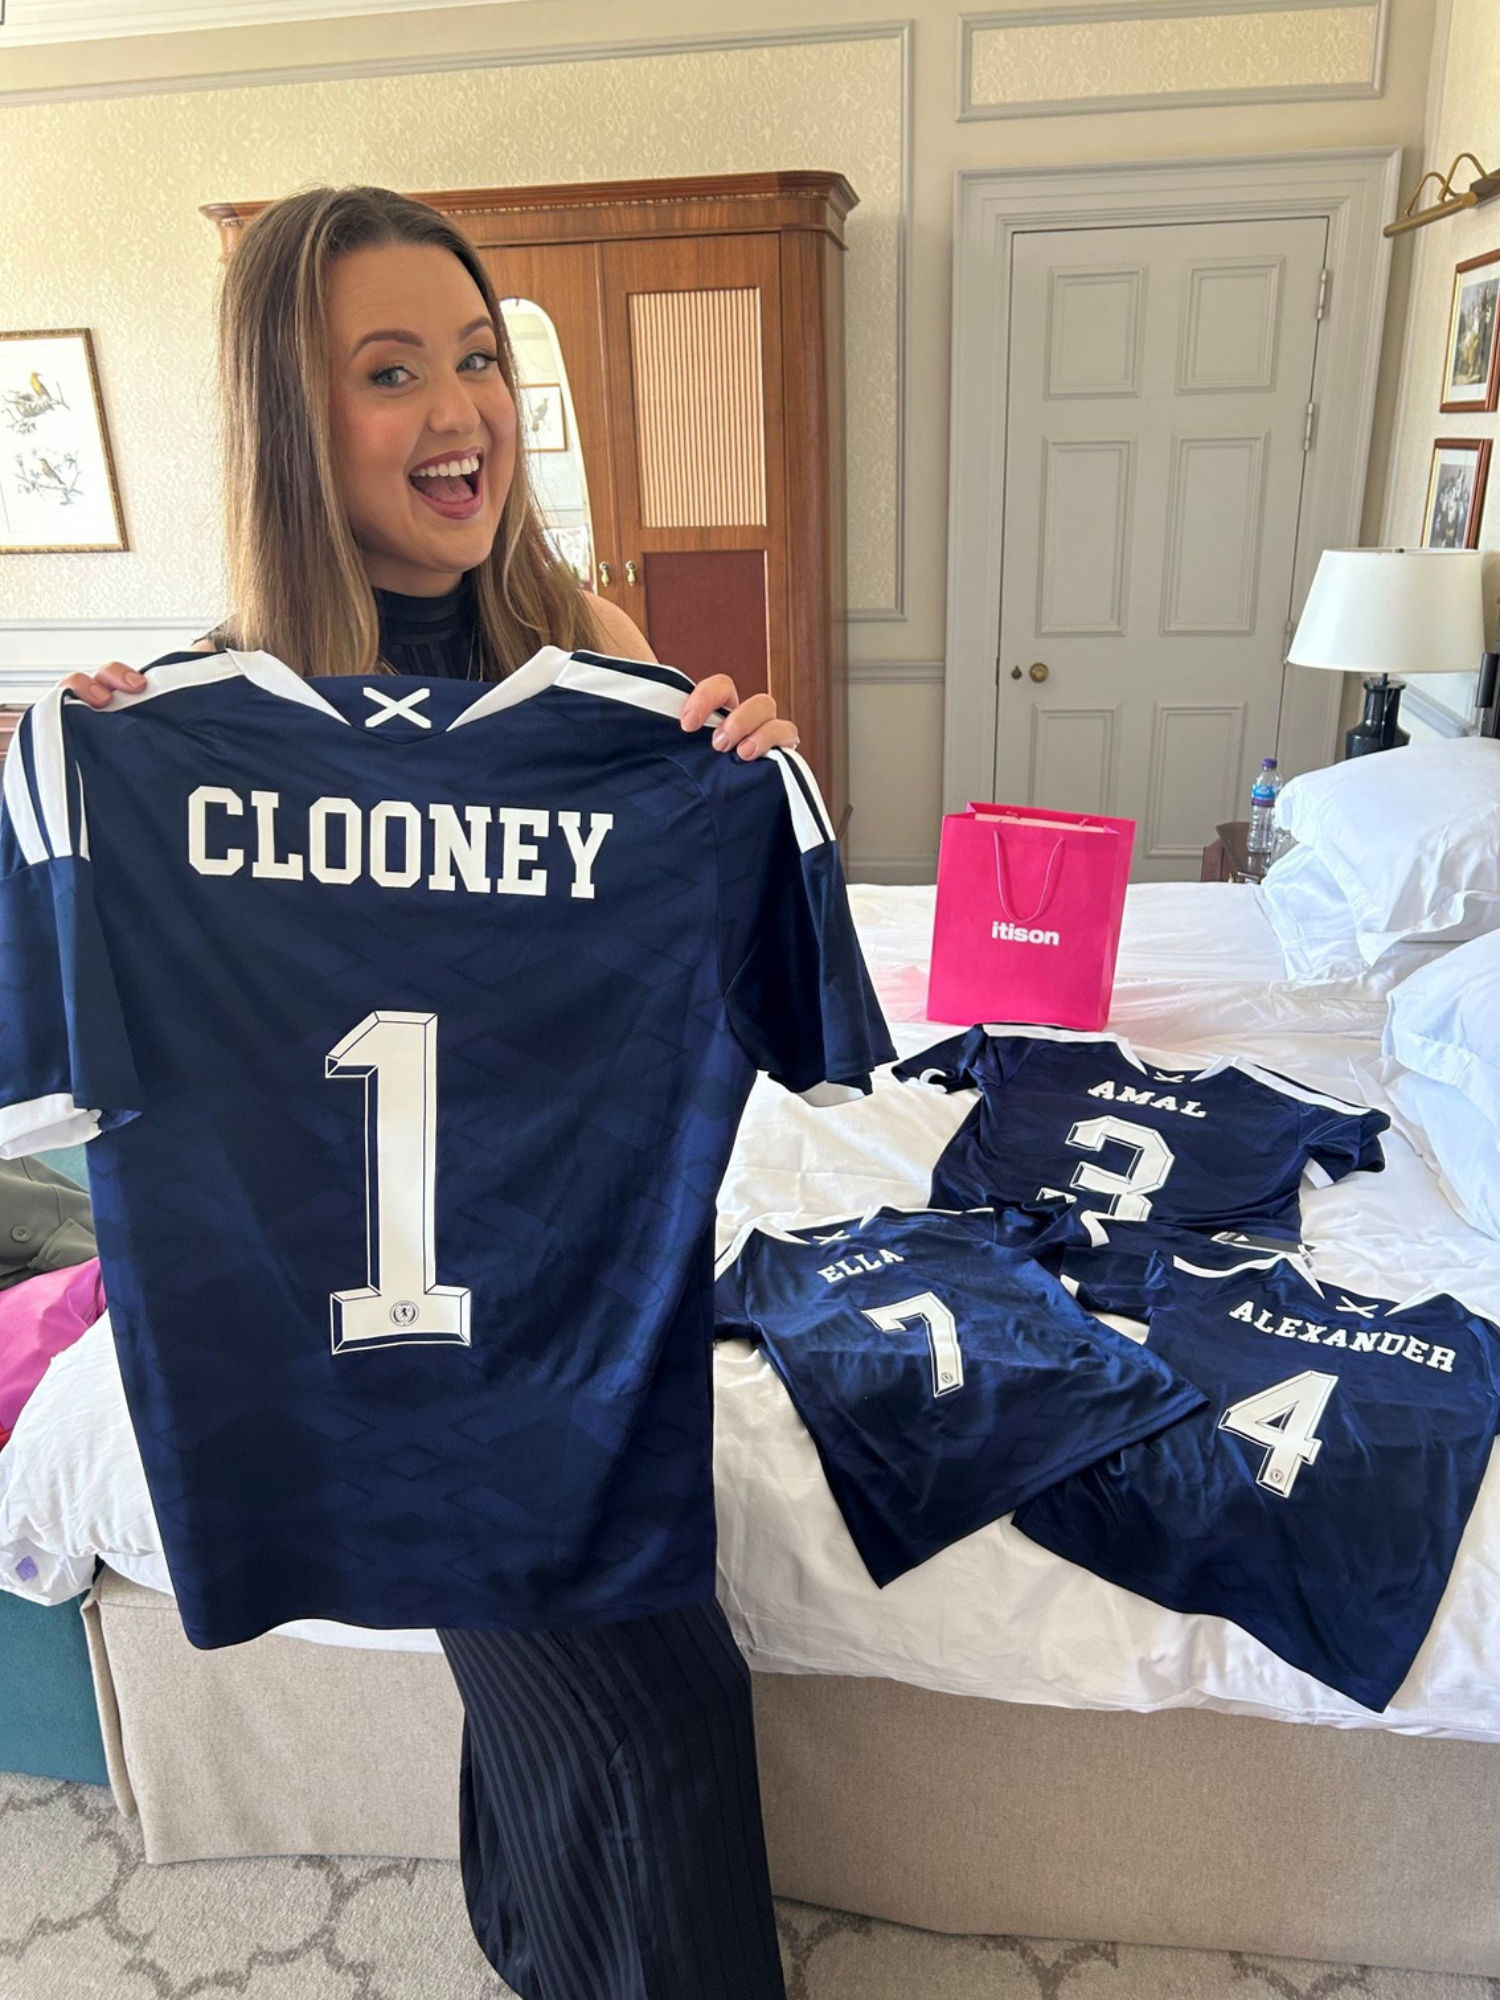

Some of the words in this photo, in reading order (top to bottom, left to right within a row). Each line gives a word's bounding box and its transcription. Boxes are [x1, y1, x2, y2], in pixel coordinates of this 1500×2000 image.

[188, 786, 614, 899] CLOONEY
[991, 921, 1060, 946] itison
[1087, 1080, 1207, 1118] AMAL
[325, 1010, 472, 1355] 1
[1036, 1115, 1175, 1222] 3
[816, 1249, 905, 1284] ELLA
[860, 1291, 964, 1398] 7
[1228, 1300, 1457, 1373] ALEXANDER
[1217, 1369, 1340, 1498] 4
